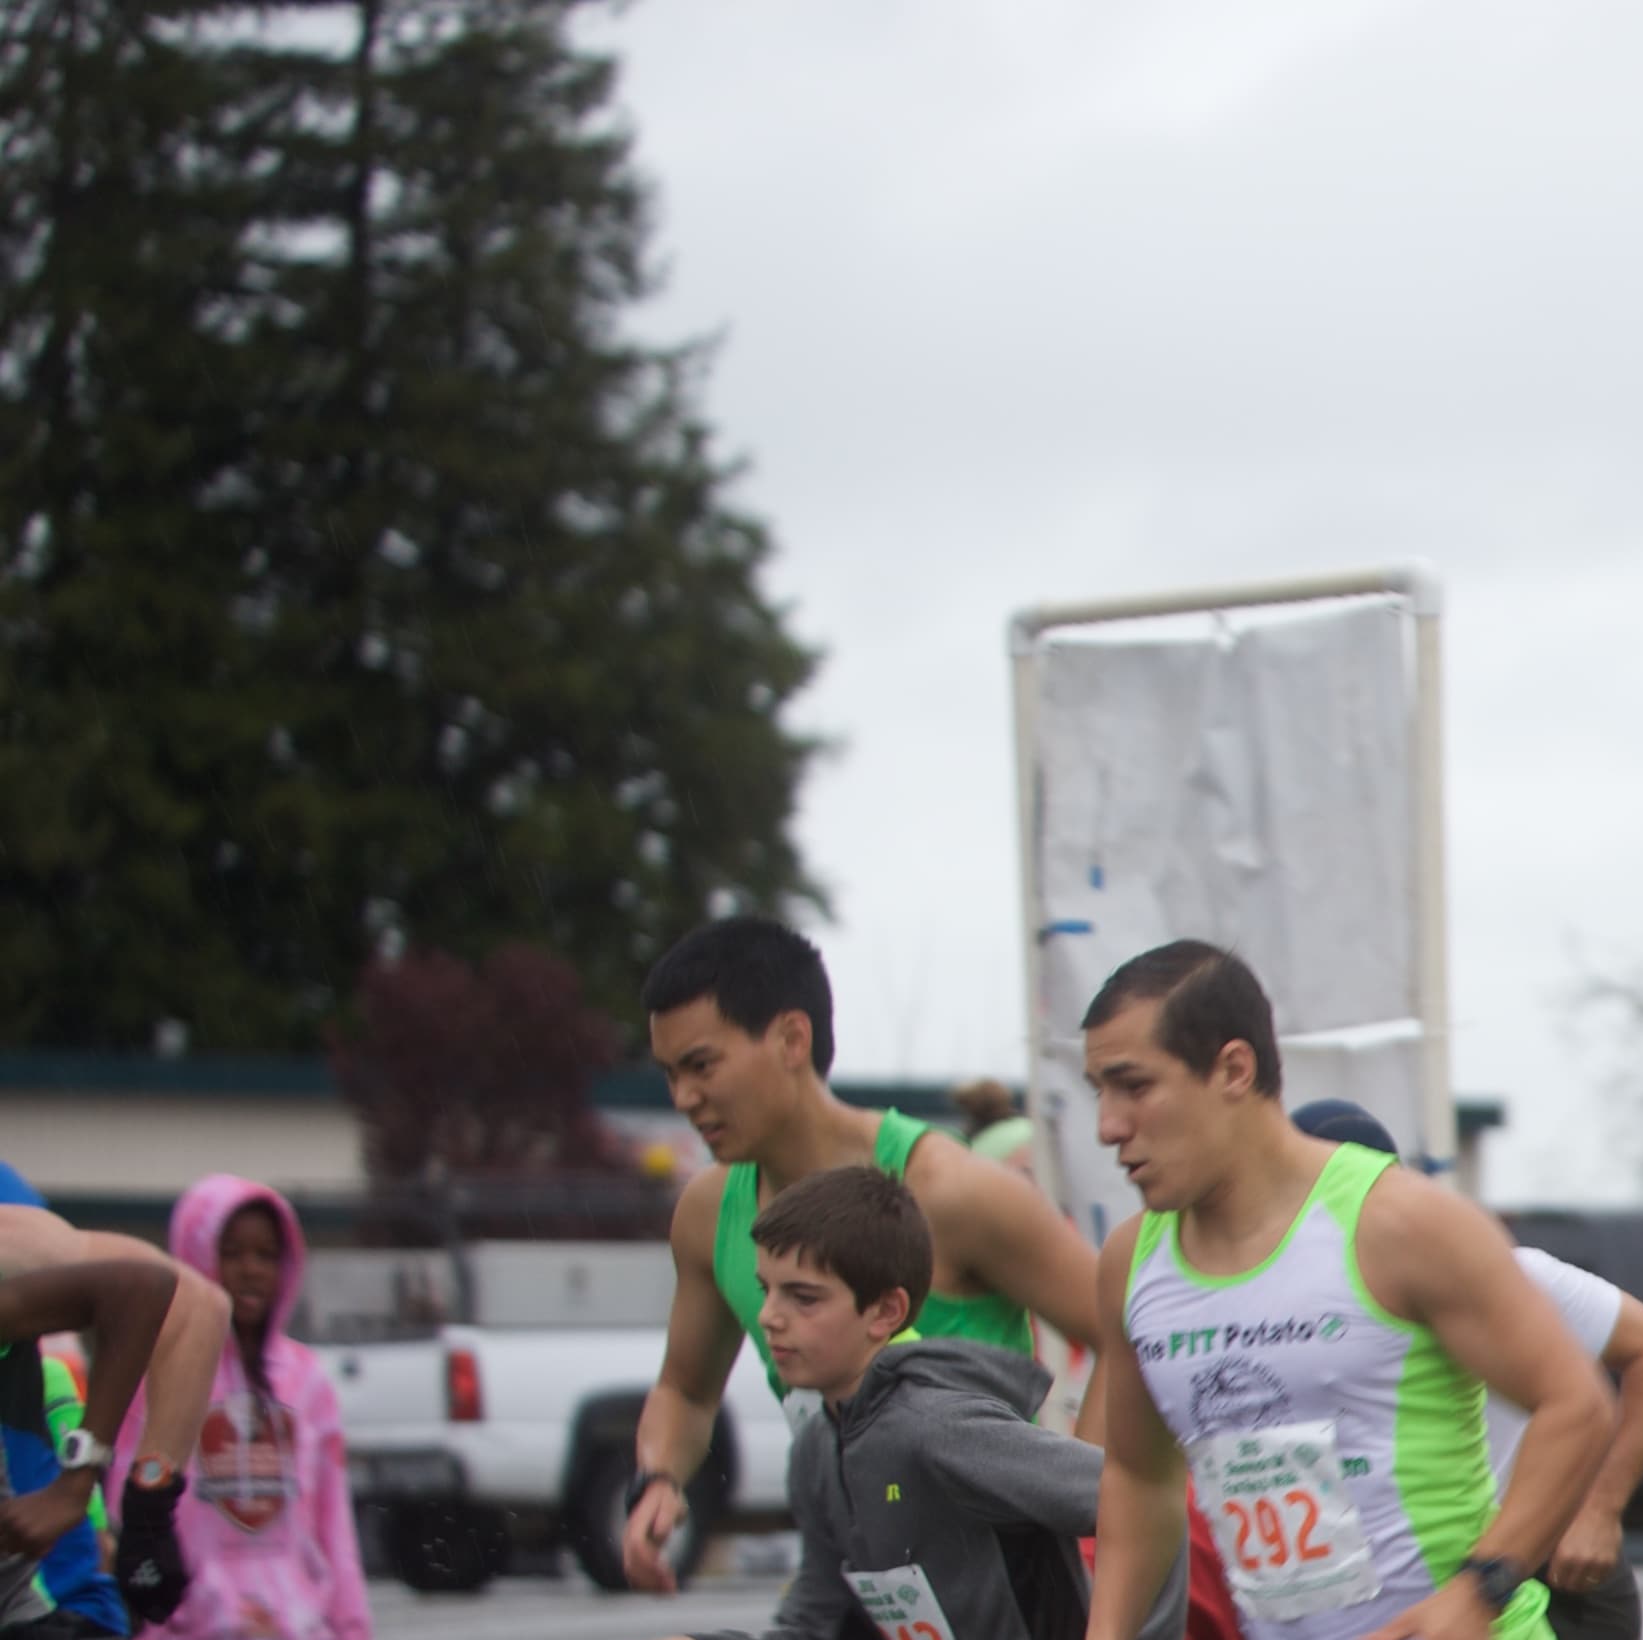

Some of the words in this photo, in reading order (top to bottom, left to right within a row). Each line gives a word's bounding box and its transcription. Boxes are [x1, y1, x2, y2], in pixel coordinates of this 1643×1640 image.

[1168, 1328, 1218, 1359] FIT
[1223, 1315, 1314, 1350] Potato
[1223, 1490, 1333, 1571] 292
